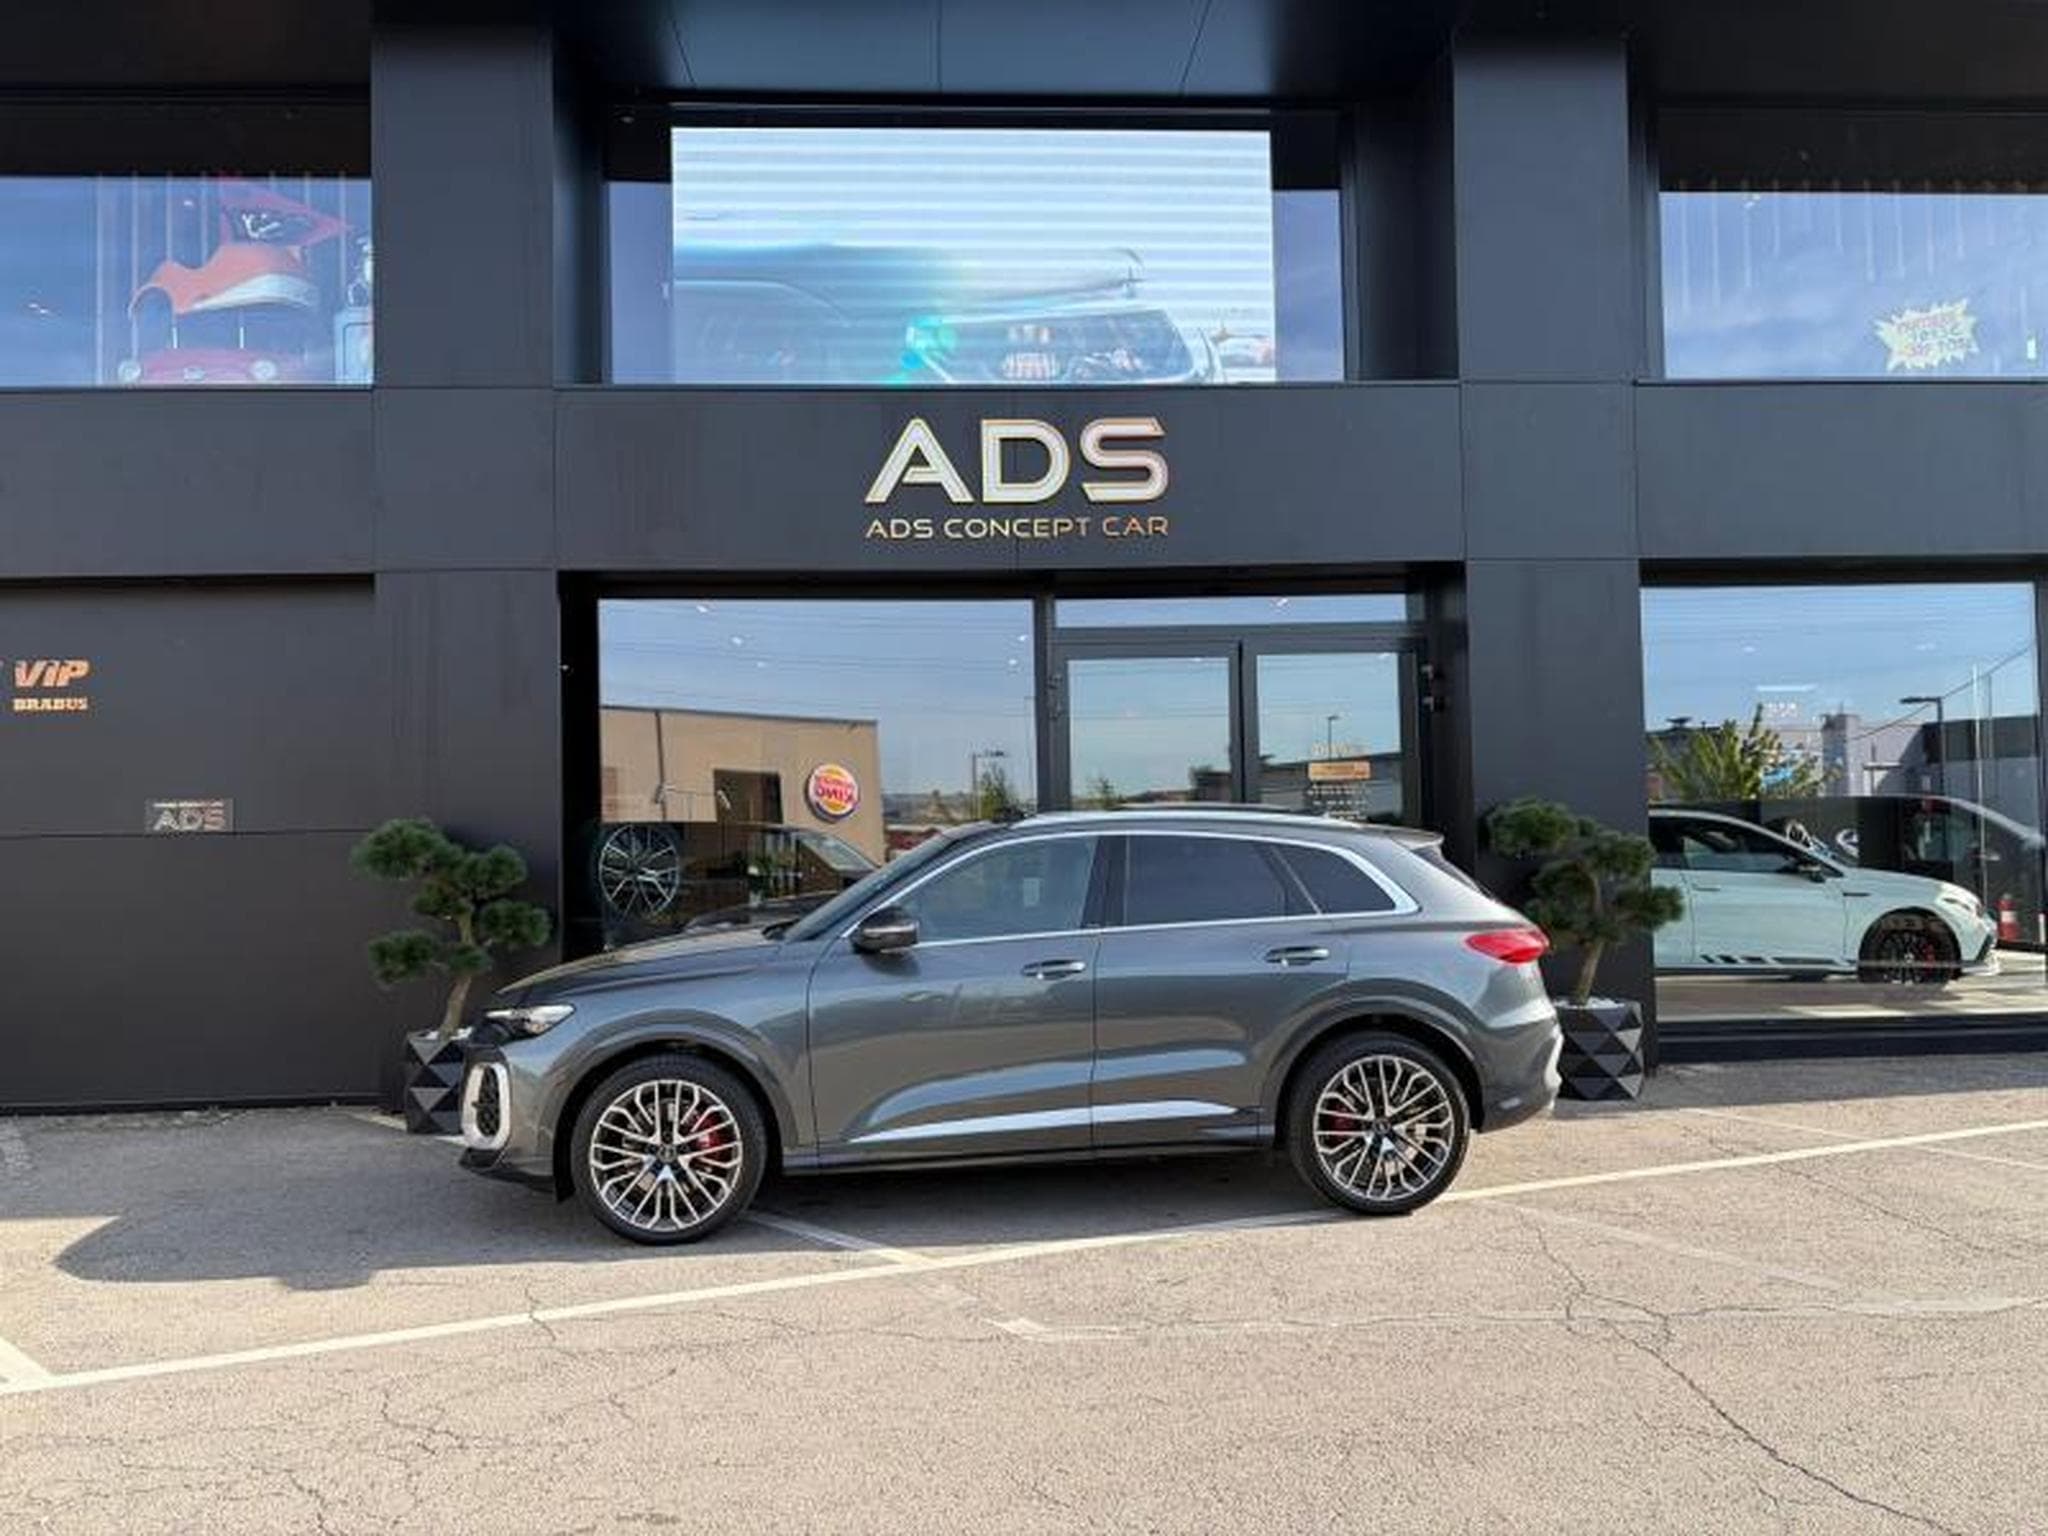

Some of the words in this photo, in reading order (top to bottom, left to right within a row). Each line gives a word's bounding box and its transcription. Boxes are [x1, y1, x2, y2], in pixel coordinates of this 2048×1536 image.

[865, 418, 1168, 503] ADS
[865, 519, 933, 538] ADS
[944, 517, 1091, 538] CONCEPT
[1102, 516, 1169, 537] CAR
[14, 698, 88, 710] BRABUS
